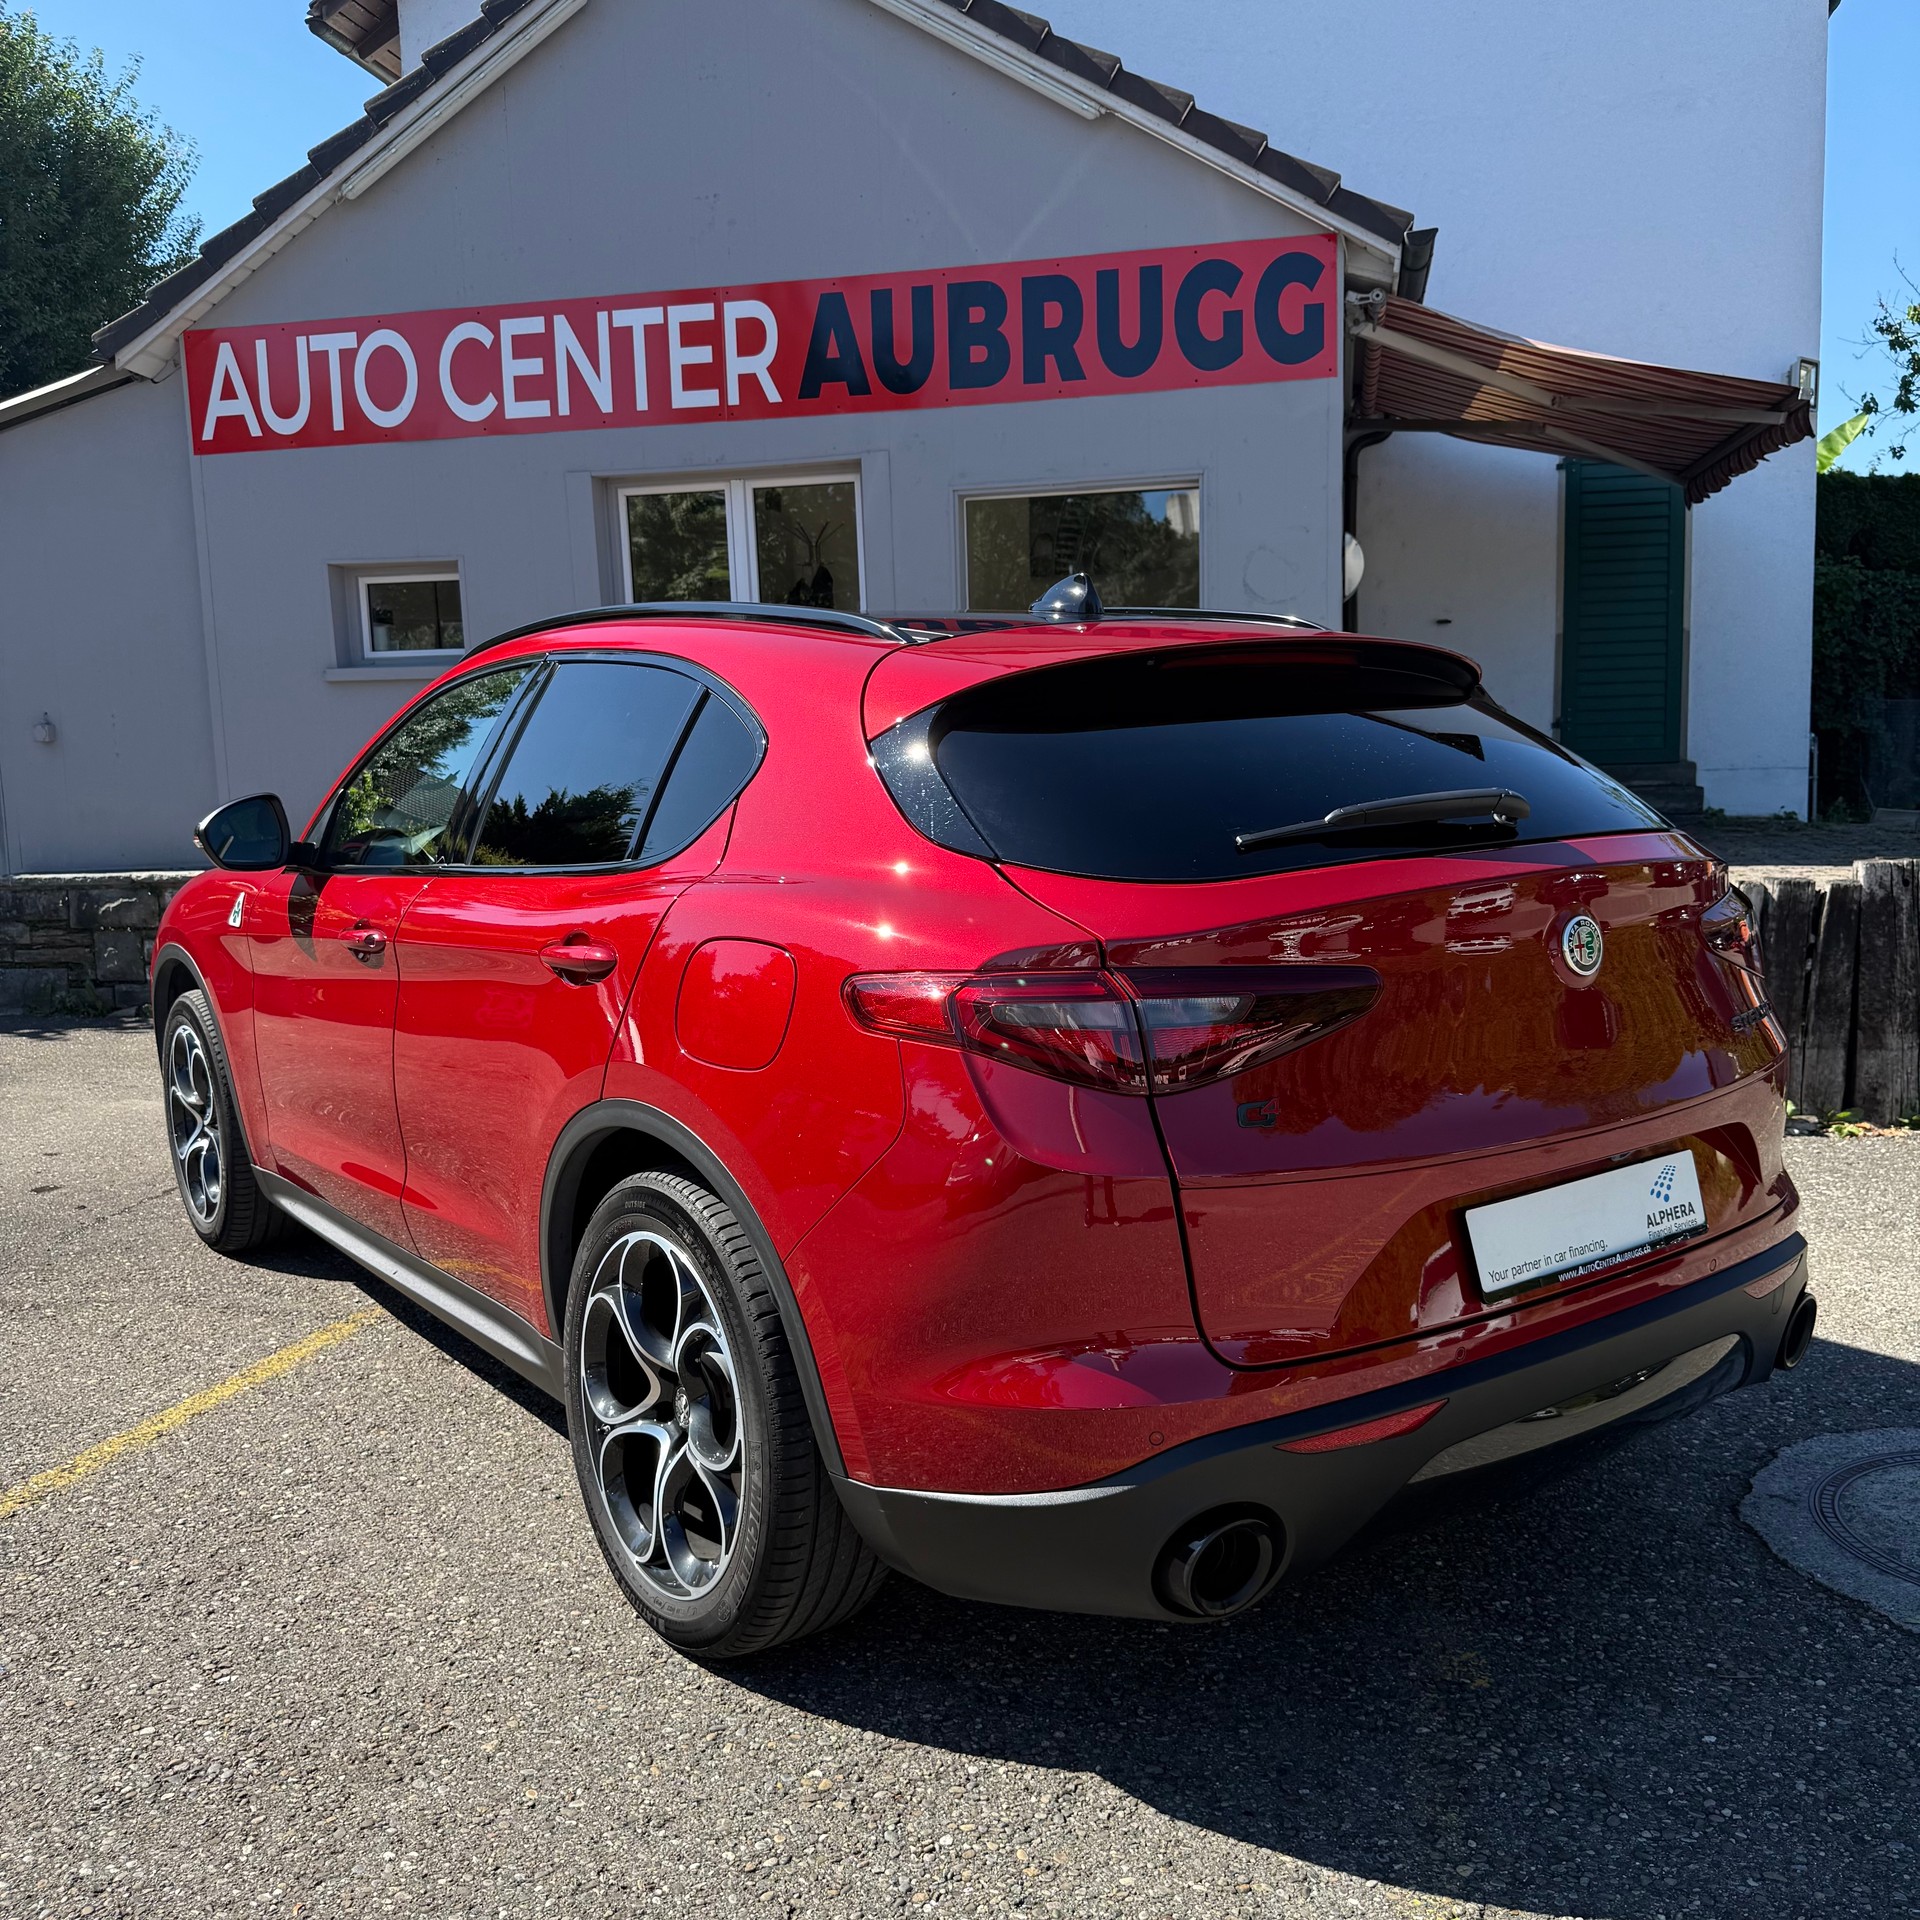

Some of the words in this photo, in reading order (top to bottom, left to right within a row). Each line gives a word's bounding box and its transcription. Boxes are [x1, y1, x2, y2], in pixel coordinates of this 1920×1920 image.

[202, 329, 418, 441] AUTO
[439, 300, 783, 422] CENTER
[798, 251, 1326, 400] AUBRUGG
[1568, 924, 1580, 948] ALFA
[624, 1200, 646, 1209] OUTSIDE
[1646, 1201, 1696, 1229] ALPHERA
[1647, 1221, 1674, 1240] Financial
[1673, 1217, 1698, 1232] Services
[1488, 1266, 1509, 1284] Your
[1510, 1258, 1542, 1280] partner
[1543, 1254, 1553, 1267] in
[1554, 1250, 1567, 1263] car
[1568, 1239, 1608, 1259] financing.
